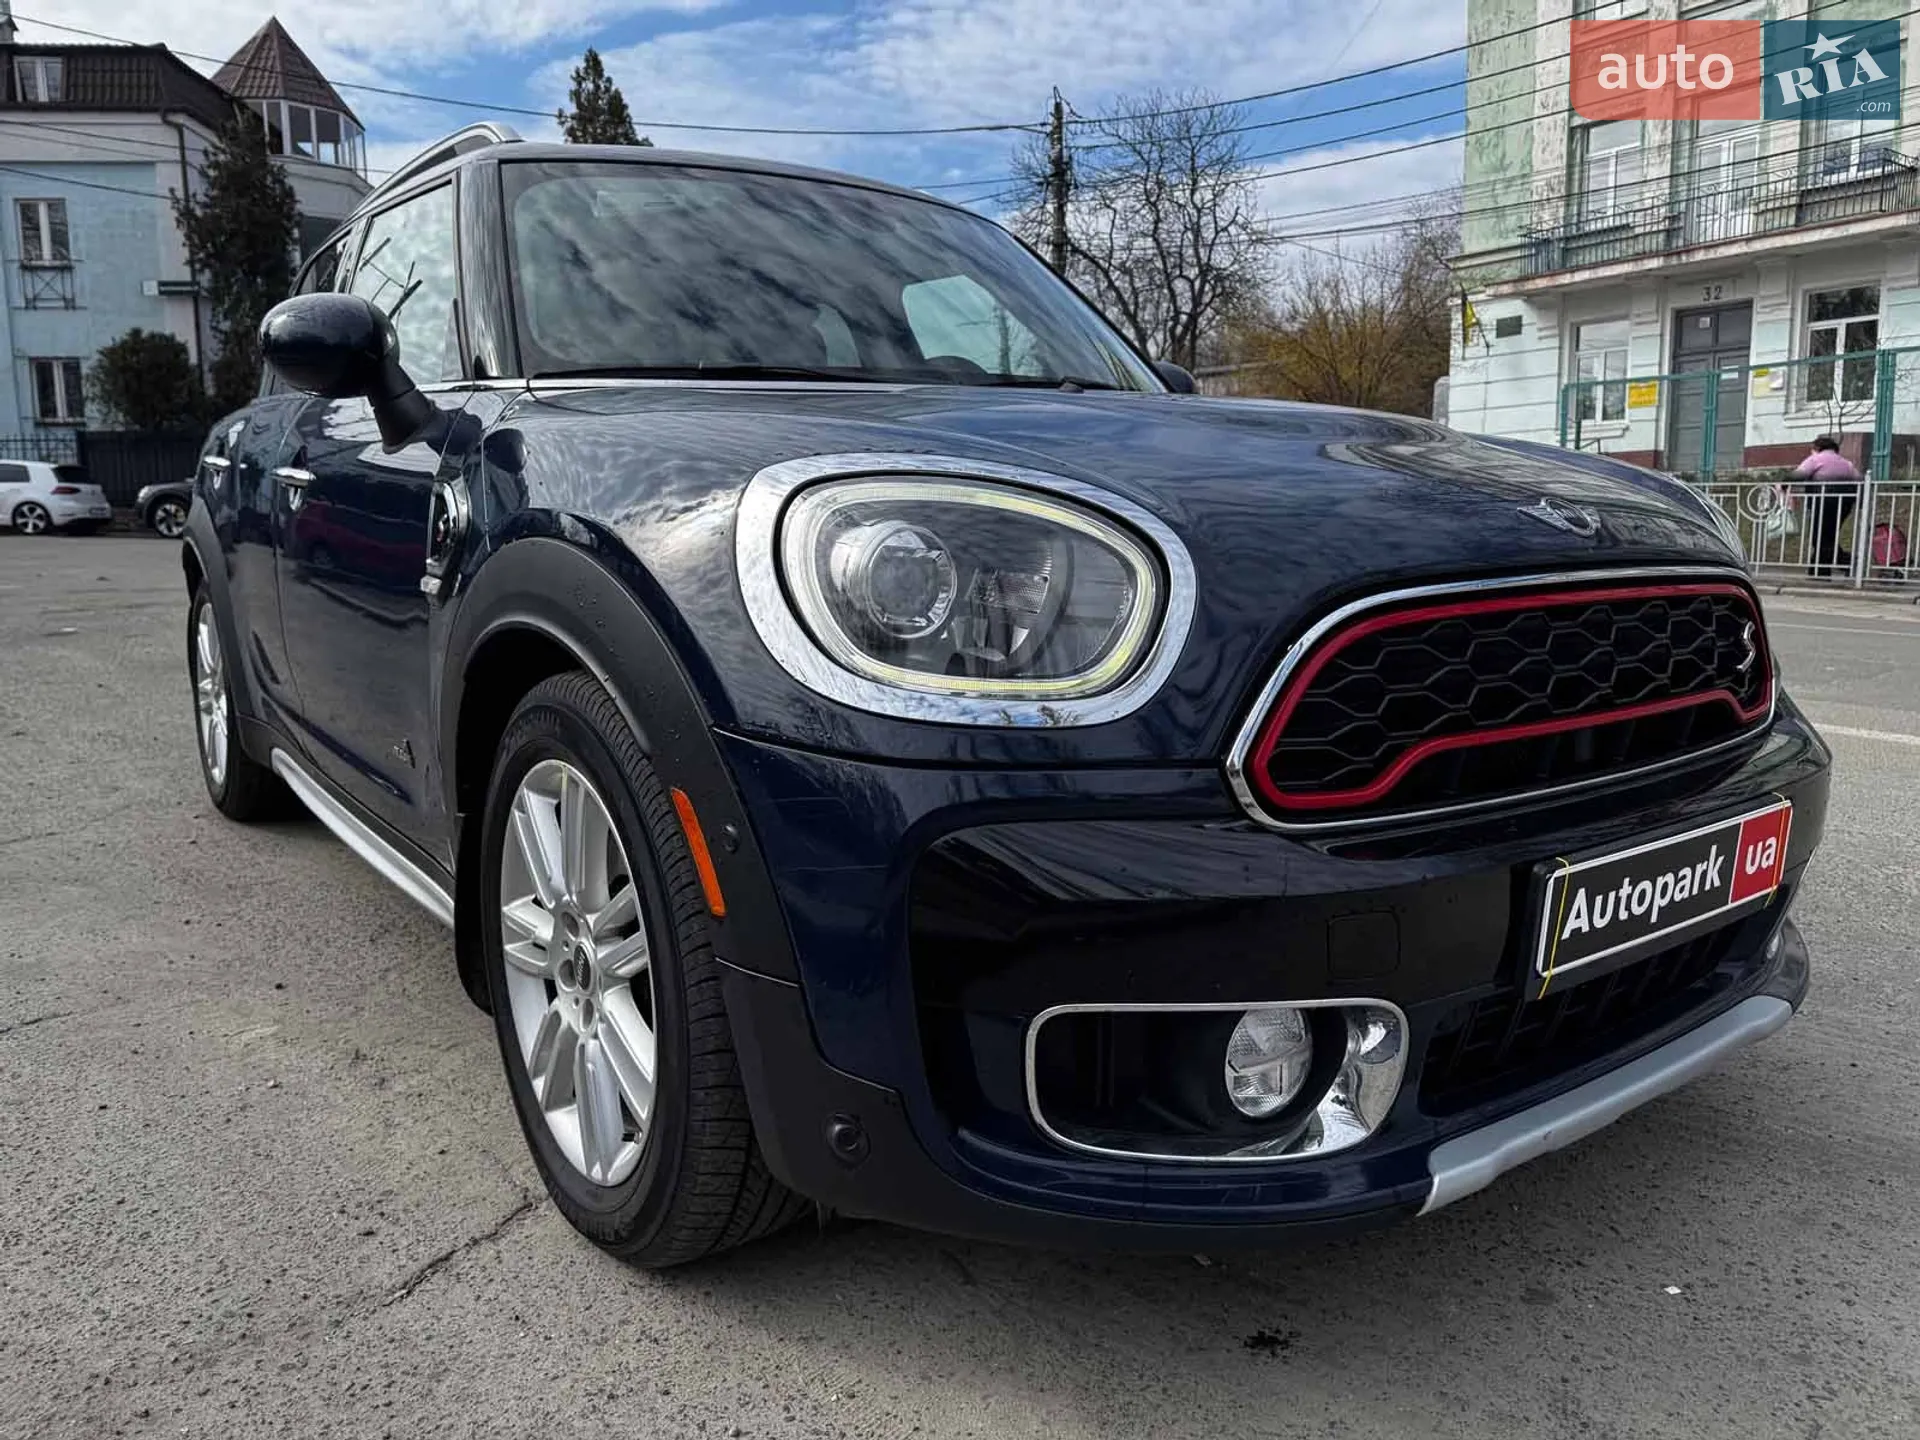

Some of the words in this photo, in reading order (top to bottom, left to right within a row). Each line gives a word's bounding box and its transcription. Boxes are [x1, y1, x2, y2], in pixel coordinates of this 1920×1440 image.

[1702, 286, 1722, 301] 32
[1561, 844, 1725, 940] Autopark
[1745, 836, 1777, 875] ua
